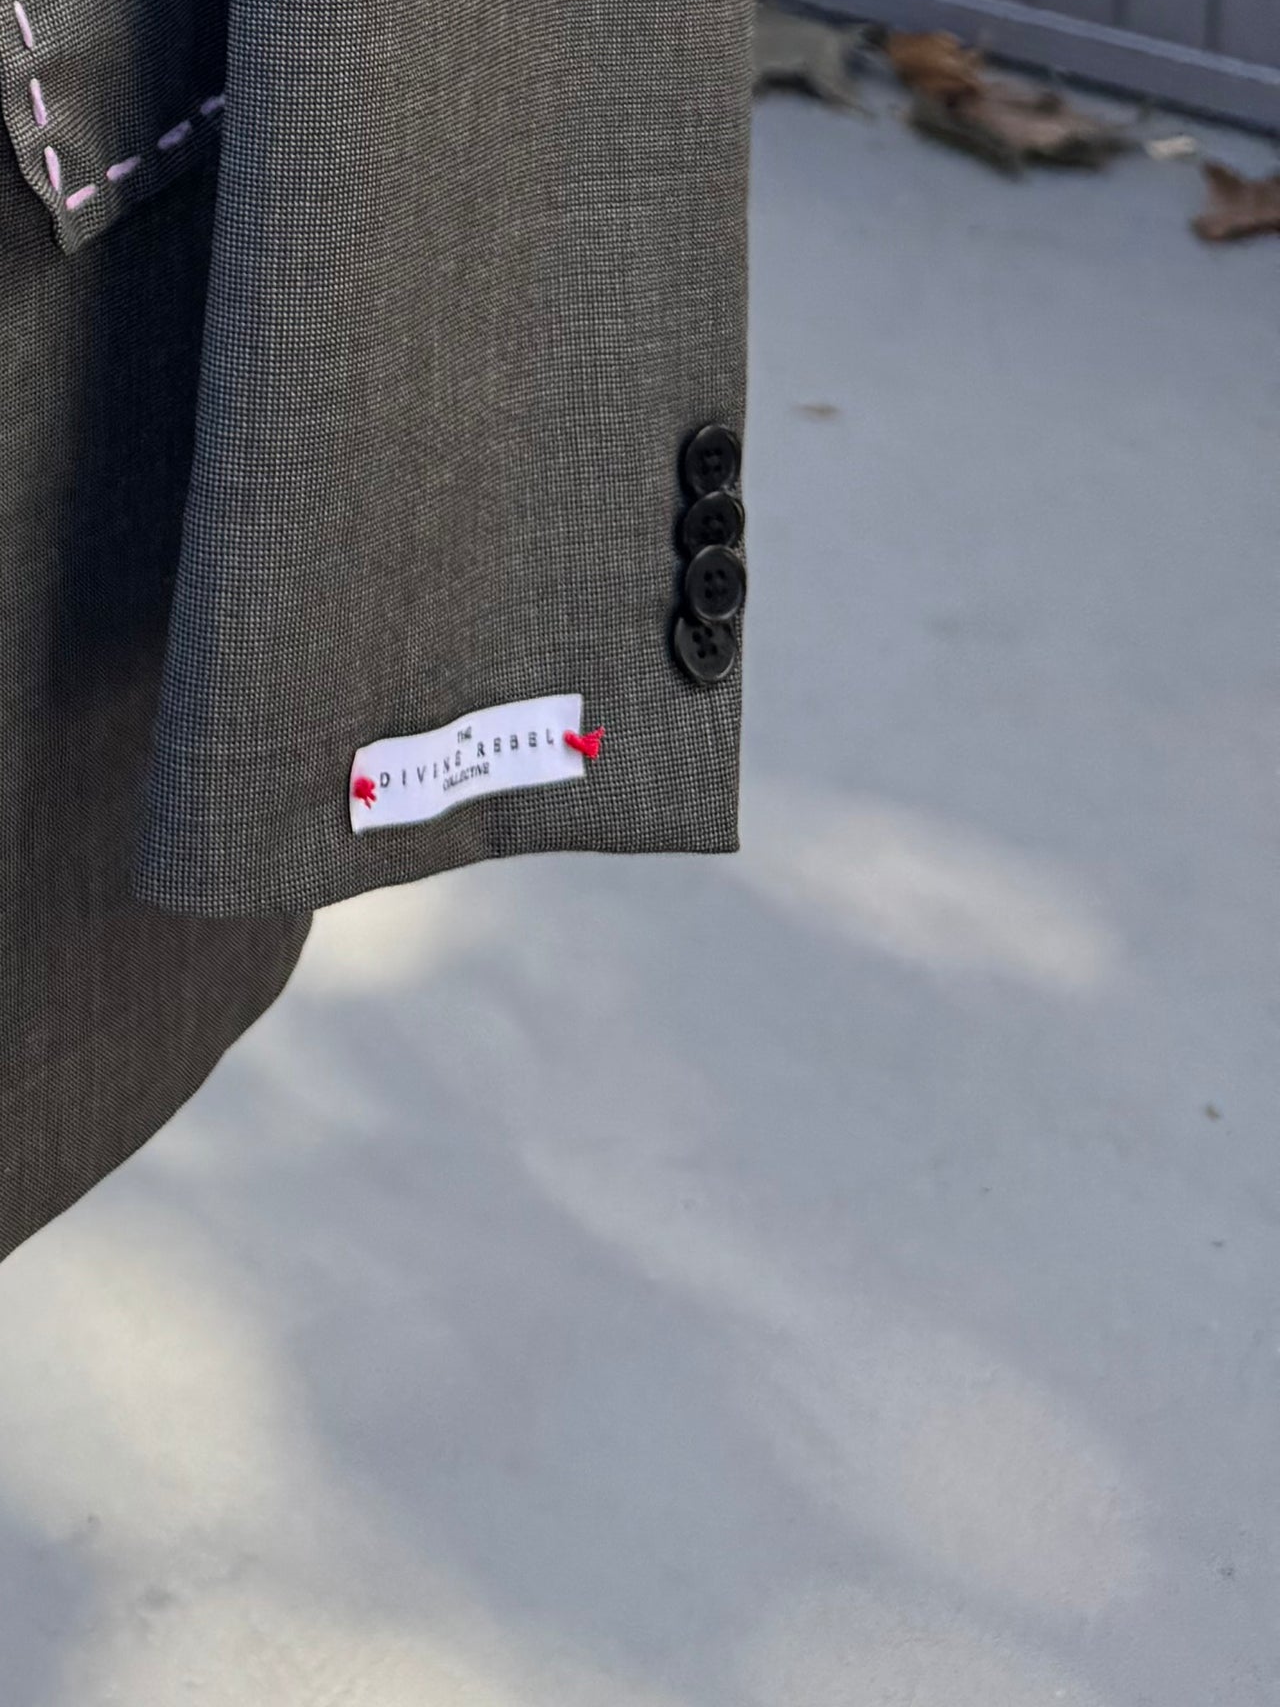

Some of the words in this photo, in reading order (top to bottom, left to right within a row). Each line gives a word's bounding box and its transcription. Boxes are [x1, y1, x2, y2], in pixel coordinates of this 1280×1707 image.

[380, 750, 461, 788] DIVINE
[477, 728, 554, 757] REBEL
[443, 761, 490, 791] COLLECTIVE
